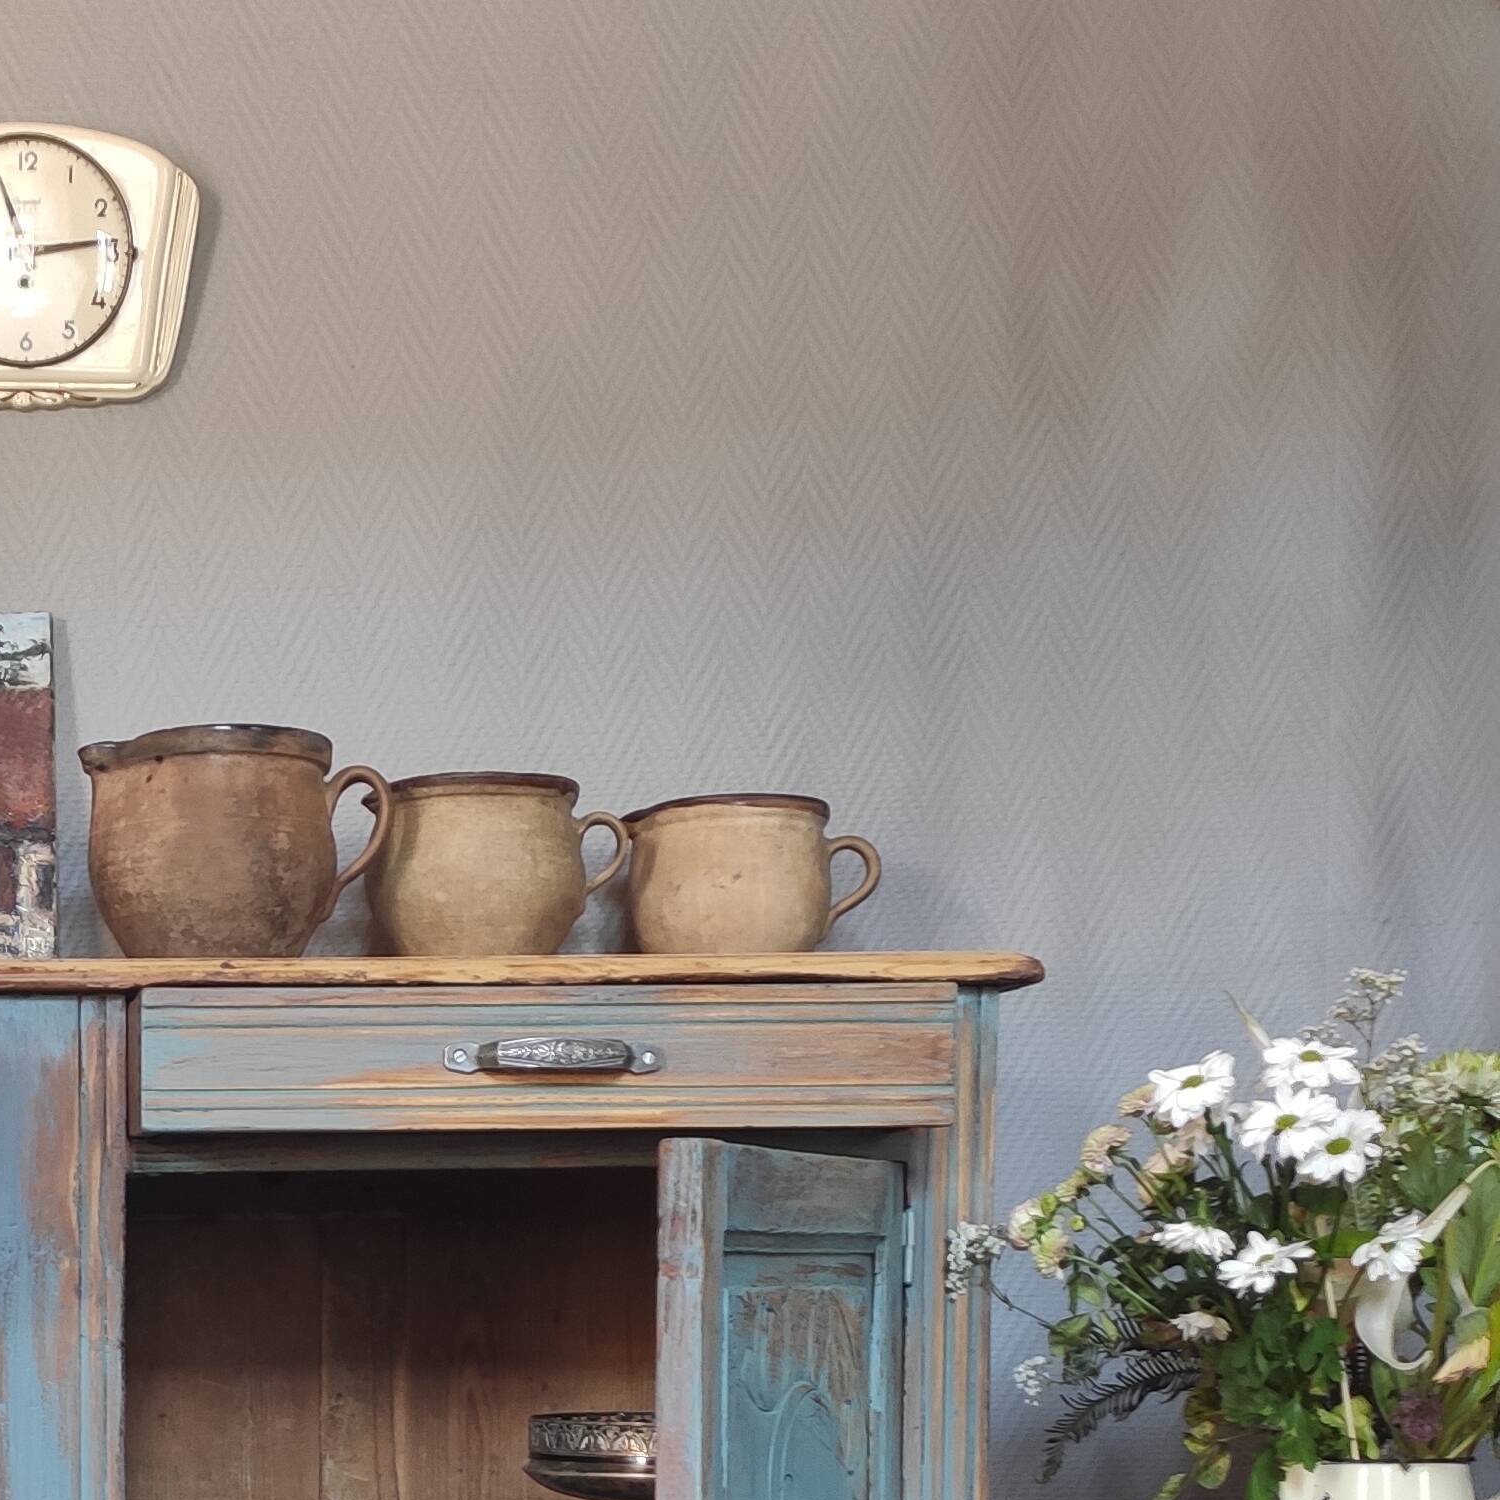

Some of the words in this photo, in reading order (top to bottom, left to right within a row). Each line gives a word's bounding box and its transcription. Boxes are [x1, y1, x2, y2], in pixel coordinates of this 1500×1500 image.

[18, 151, 38, 171] 12
[68, 165, 73, 183] 1
[94, 198, 108, 218] 2
[106, 238, 120, 263] 3
[91, 290, 106, 309] 4
[62, 320, 75, 340] 5
[19, 332, 33, 352] 6
